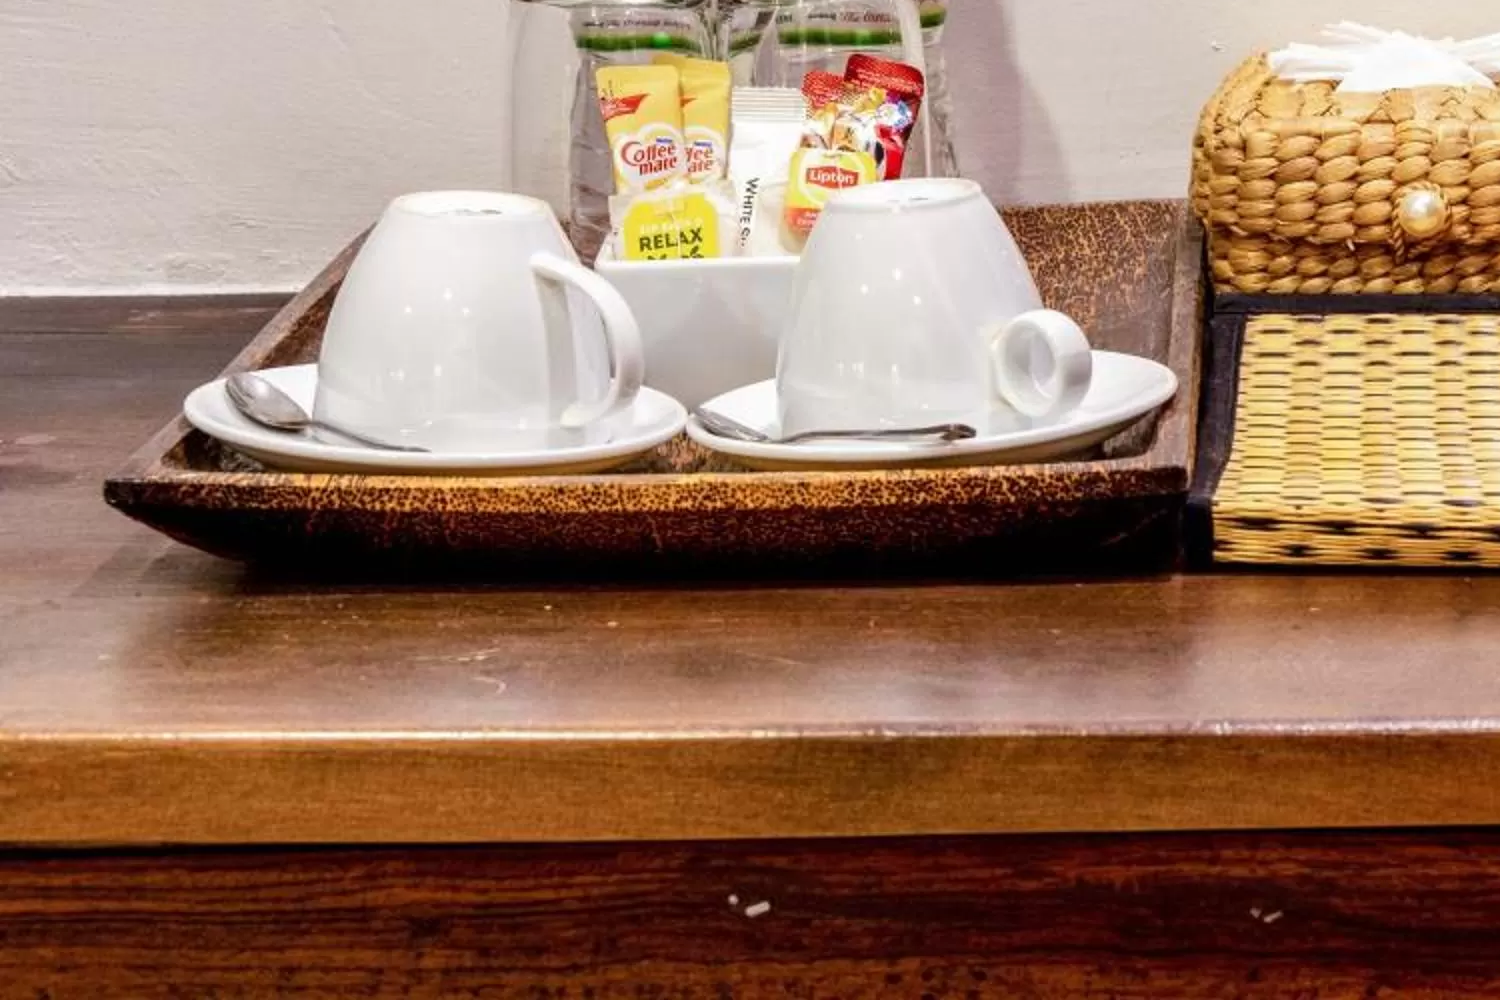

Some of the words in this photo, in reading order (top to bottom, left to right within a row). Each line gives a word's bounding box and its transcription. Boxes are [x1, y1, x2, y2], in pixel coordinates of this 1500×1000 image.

[621, 141, 678, 167] Coffee
[639, 156, 678, 176] mate
[687, 160, 713, 174] ate
[809, 168, 855, 186] Lipton
[740, 177, 760, 224] WHITE
[639, 227, 703, 252] RELAX
